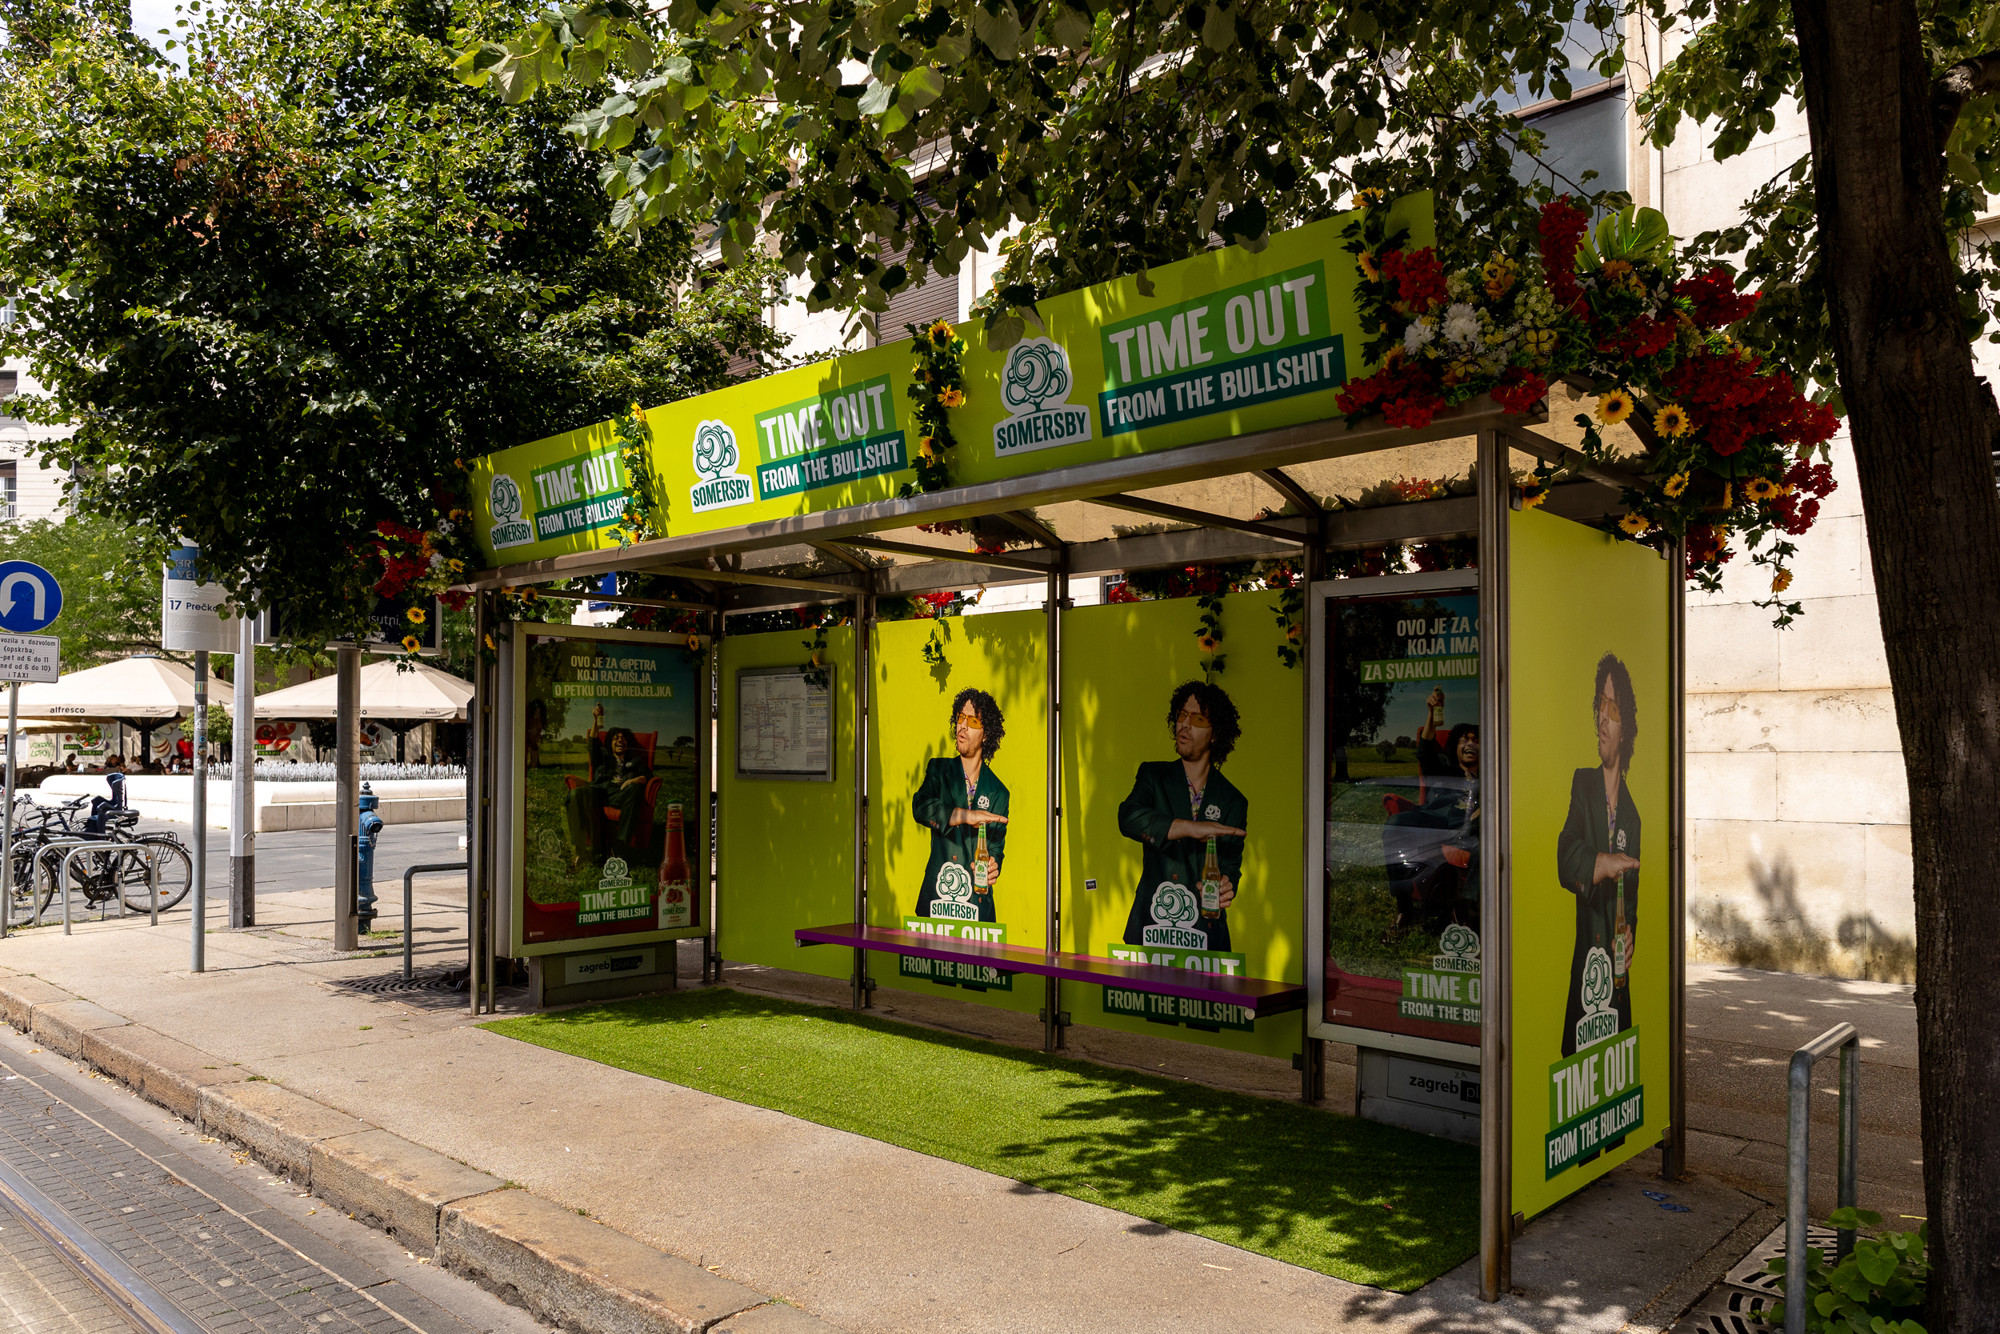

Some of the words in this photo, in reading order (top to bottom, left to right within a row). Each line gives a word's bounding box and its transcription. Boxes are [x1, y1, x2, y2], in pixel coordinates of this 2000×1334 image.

[1108, 305, 1213, 382] TIME
[1224, 273, 1315, 357] OUT
[1107, 387, 1166, 427] FROM
[1170, 375, 1215, 411] THE
[1220, 346, 1334, 402] BULLSHIT
[760, 404, 826, 459] TIME
[831, 384, 886, 441] OUT
[997, 411, 1086, 450] SOMERSBY
[762, 464, 800, 493] FROM
[801, 457, 830, 483] THE
[831, 439, 899, 477] BULLSHIT
[535, 464, 580, 508] TIME
[582, 451, 618, 495] OUT
[692, 479, 750, 507] SOMERSBY
[538, 511, 565, 535] FROM
[565, 506, 585, 529] THE
[492, 523, 532, 545] SOMERSBY
[170, 600, 181, 610] 17
[1397, 619, 1426, 636] OVO
[1430, 618, 1447, 634] JE
[1451, 616, 1470, 634] ZA
[1408, 638, 1446, 655] KOJA
[1450, 636, 1479, 653] IMA
[571, 655, 590, 667] OVO
[592, 657, 603, 668] JE
[605, 657, 618, 669] ZA
[619, 658, 656, 671] @PETRA
[1364, 664, 1382, 680] ZA
[1386, 661, 1434, 679] SVAKU
[577, 669, 598, 681] KOJI
[601, 669, 651, 684] RAZMIŠLJA
[555, 684, 561, 696] O
[564, 685, 594, 696] PETKU
[597, 685, 609, 696] OD
[611, 685, 672, 697] PONEDJELJKA
[50, 706, 85, 714] alfresco
[600, 878, 632, 888] SOMERSBY
[582, 891, 616, 911] TIME
[621, 887, 648, 906] OUT
[579, 912, 600, 924] FROM
[602, 910, 616, 921] THE
[617, 907, 650, 919] BULLSHIT
[932, 903, 977, 920] SOMERSBY
[1145, 928, 1205, 949] SOMERSBY
[579, 960, 610, 973] zagreb
[903, 956, 931, 974] FROM
[934, 959, 954, 977] THE
[1435, 957, 1480, 973] SOMERSB
[1406, 972, 1461, 1001] TIME
[1108, 989, 1144, 1012] FROM
[1149, 994, 1175, 1015] THE
[1180, 998, 1247, 1024] BULLSHIT
[1402, 1001, 1434, 1017] FROM
[1437, 1005, 1459, 1021] THE
[1578, 1013, 1617, 1046] SOMERSBY
[1409, 1075, 1458, 1094] zagreb
[1553, 1053, 1599, 1124] TIME
[1604, 1035, 1636, 1097] OUT
[1549, 1128, 1577, 1169] FROM
[1580, 1116, 1598, 1150] THE
[1600, 1094, 1641, 1140] BULLSHIT
